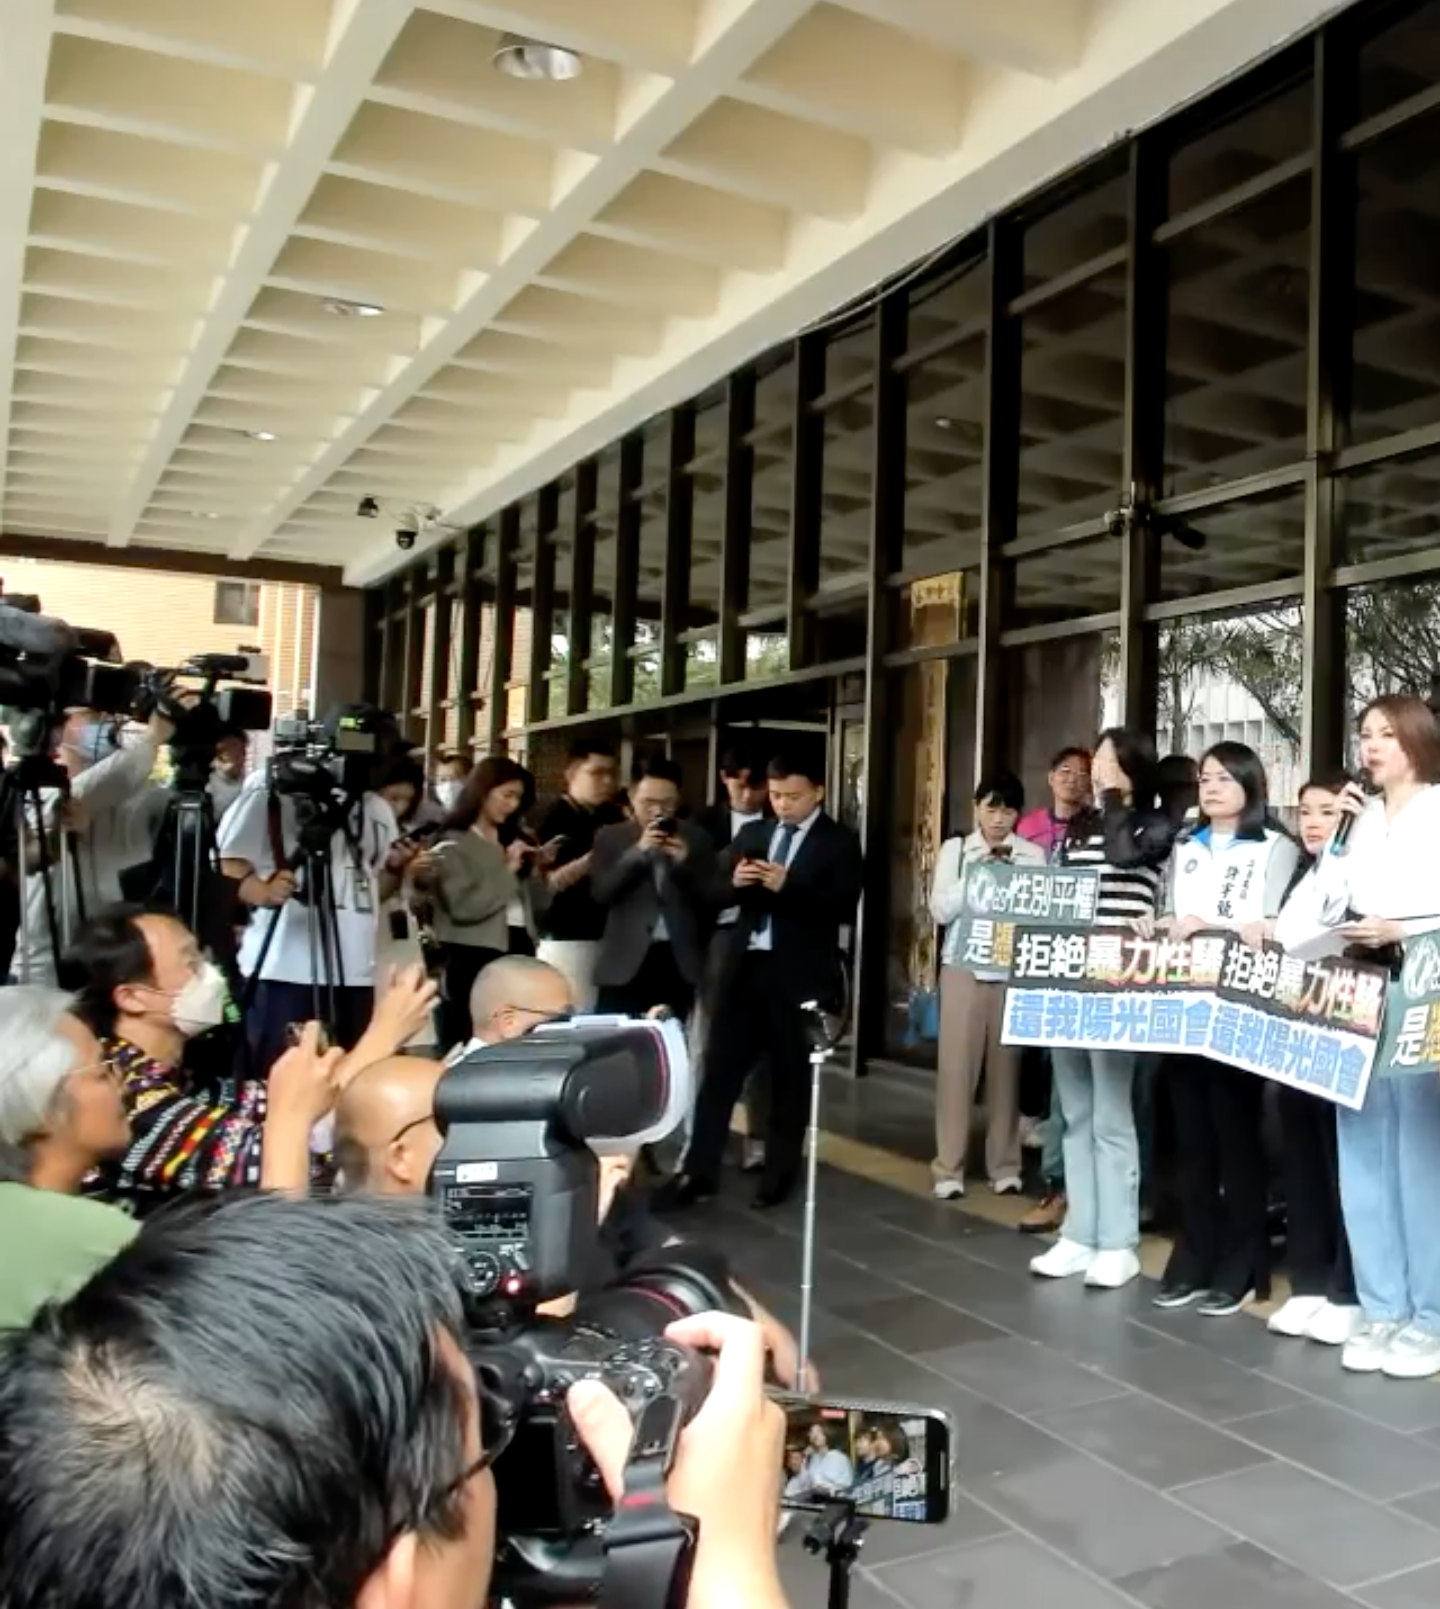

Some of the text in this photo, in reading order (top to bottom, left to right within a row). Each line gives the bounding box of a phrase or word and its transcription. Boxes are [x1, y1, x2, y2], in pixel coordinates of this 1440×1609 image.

[1009, 993, 1212, 1047] 還我陽光國會
[1209, 1004, 1367, 1099] 還我陽光國會
